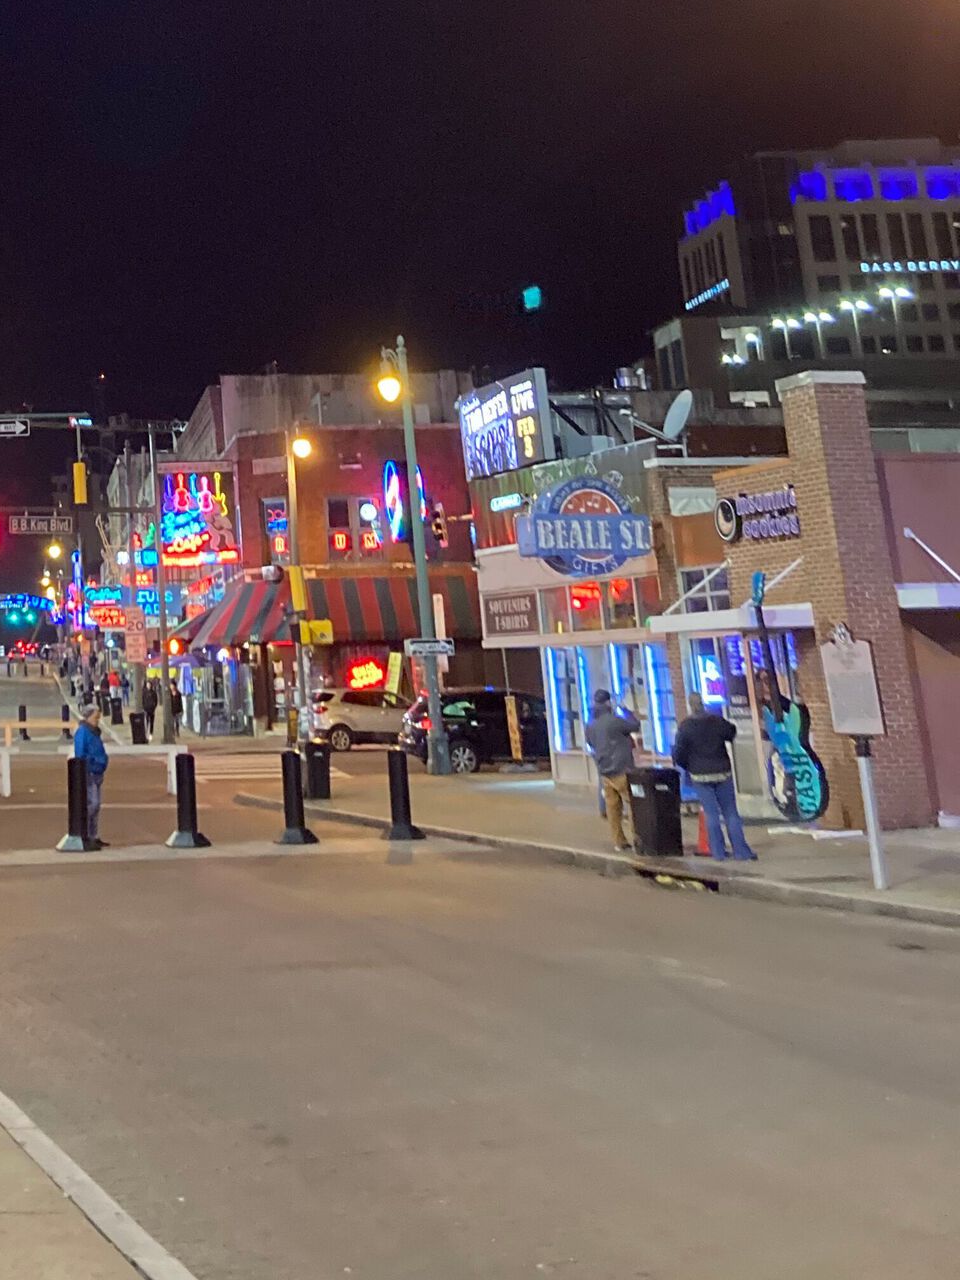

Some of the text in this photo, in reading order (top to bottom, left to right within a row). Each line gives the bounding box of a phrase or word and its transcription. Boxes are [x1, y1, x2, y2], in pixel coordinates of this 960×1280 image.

[860, 260, 959, 273] BASS BERRY
[31, 519, 48, 533] King
[536, 519, 651, 550] BEALE ST.
[742, 513, 800, 538] cookies
[572, 554, 619, 573] GIFTS
[489, 596, 531, 615] SOUVENIRS
[127, 621, 144, 632] 20
[495, 615, 529, 631] T-SHIRTS
[793, 752, 821, 817] CASH
